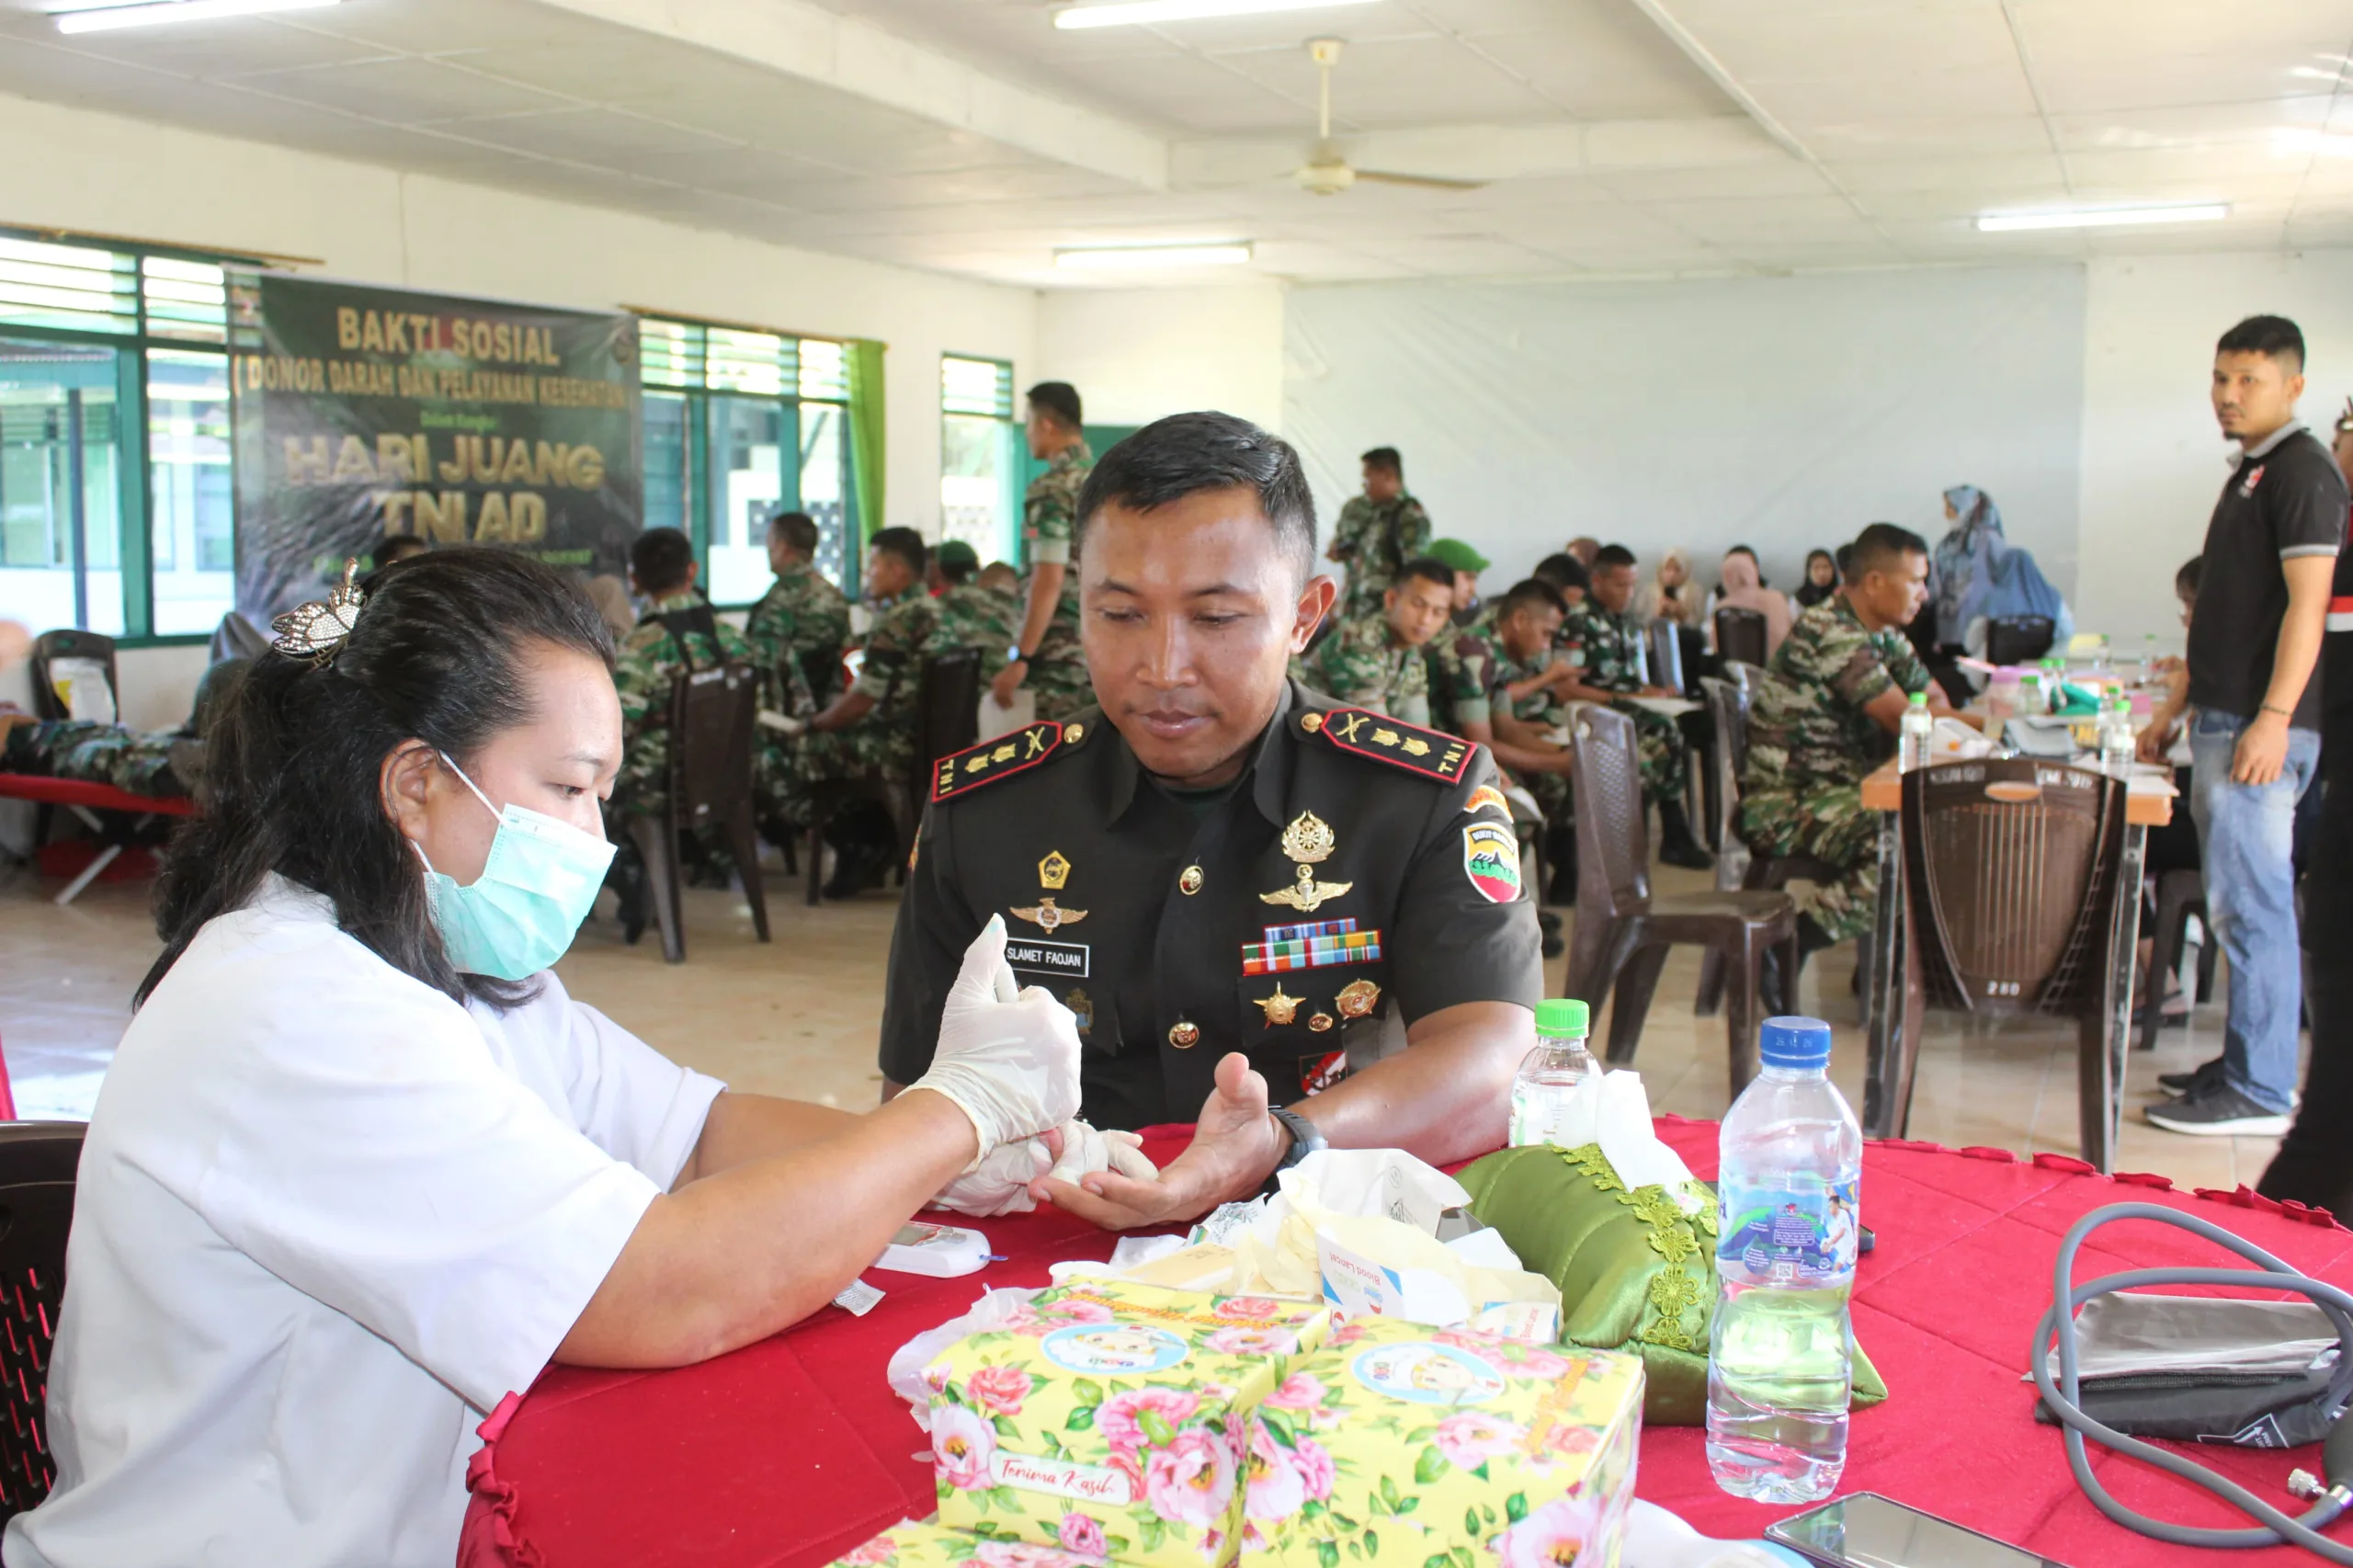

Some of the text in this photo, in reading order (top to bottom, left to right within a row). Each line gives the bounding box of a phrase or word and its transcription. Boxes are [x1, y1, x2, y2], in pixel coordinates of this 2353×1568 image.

[337, 306, 560, 366] BAKTI SOSIAL
[246, 356, 324, 392] DONOR
[327, 359, 395, 396] DARAH
[398, 365, 436, 398] DAN
[439, 369, 535, 404] PELAYANAN
[283, 433, 606, 492] HARI JUANG
[372, 491, 546, 544] TNI AD
[939, 758, 955, 795] TNI
[1438, 743, 1465, 773] TNI
[1006, 947, 1043, 963] SLAMET
[1329, 1251, 1356, 1275] Lancet
[1356, 1266, 1381, 1287] Blood
[1001, 1459, 1117, 1497] Terima Kasih
